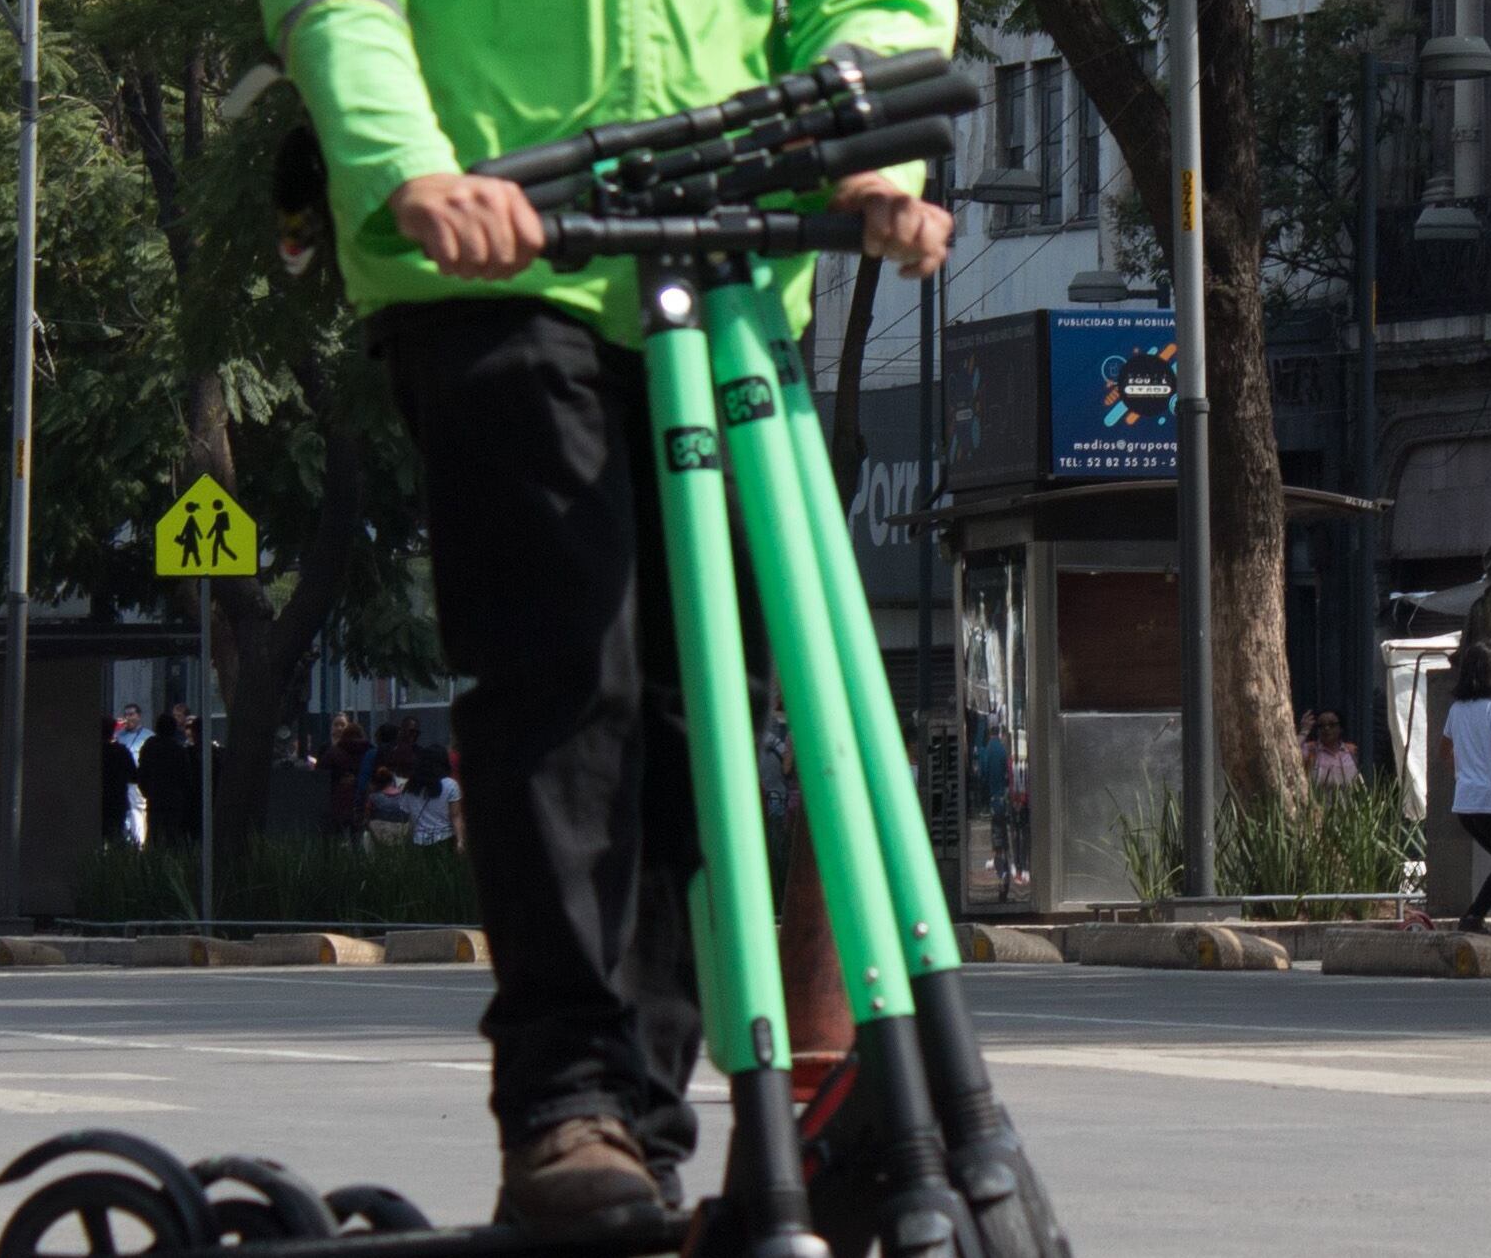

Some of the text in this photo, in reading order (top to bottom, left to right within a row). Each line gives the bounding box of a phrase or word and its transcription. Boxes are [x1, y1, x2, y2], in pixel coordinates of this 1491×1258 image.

[1058, 317, 1114, 327] PUBLICIDAD
[1117, 317, 1131, 327] EN
[1059, 457, 1082, 468] TEL:
[1087, 457, 1101, 468] 52
[1105, 457, 1120, 468] 82
[1124, 457, 1138, 468] 55
[1143, 457, 1157, 468] 35
